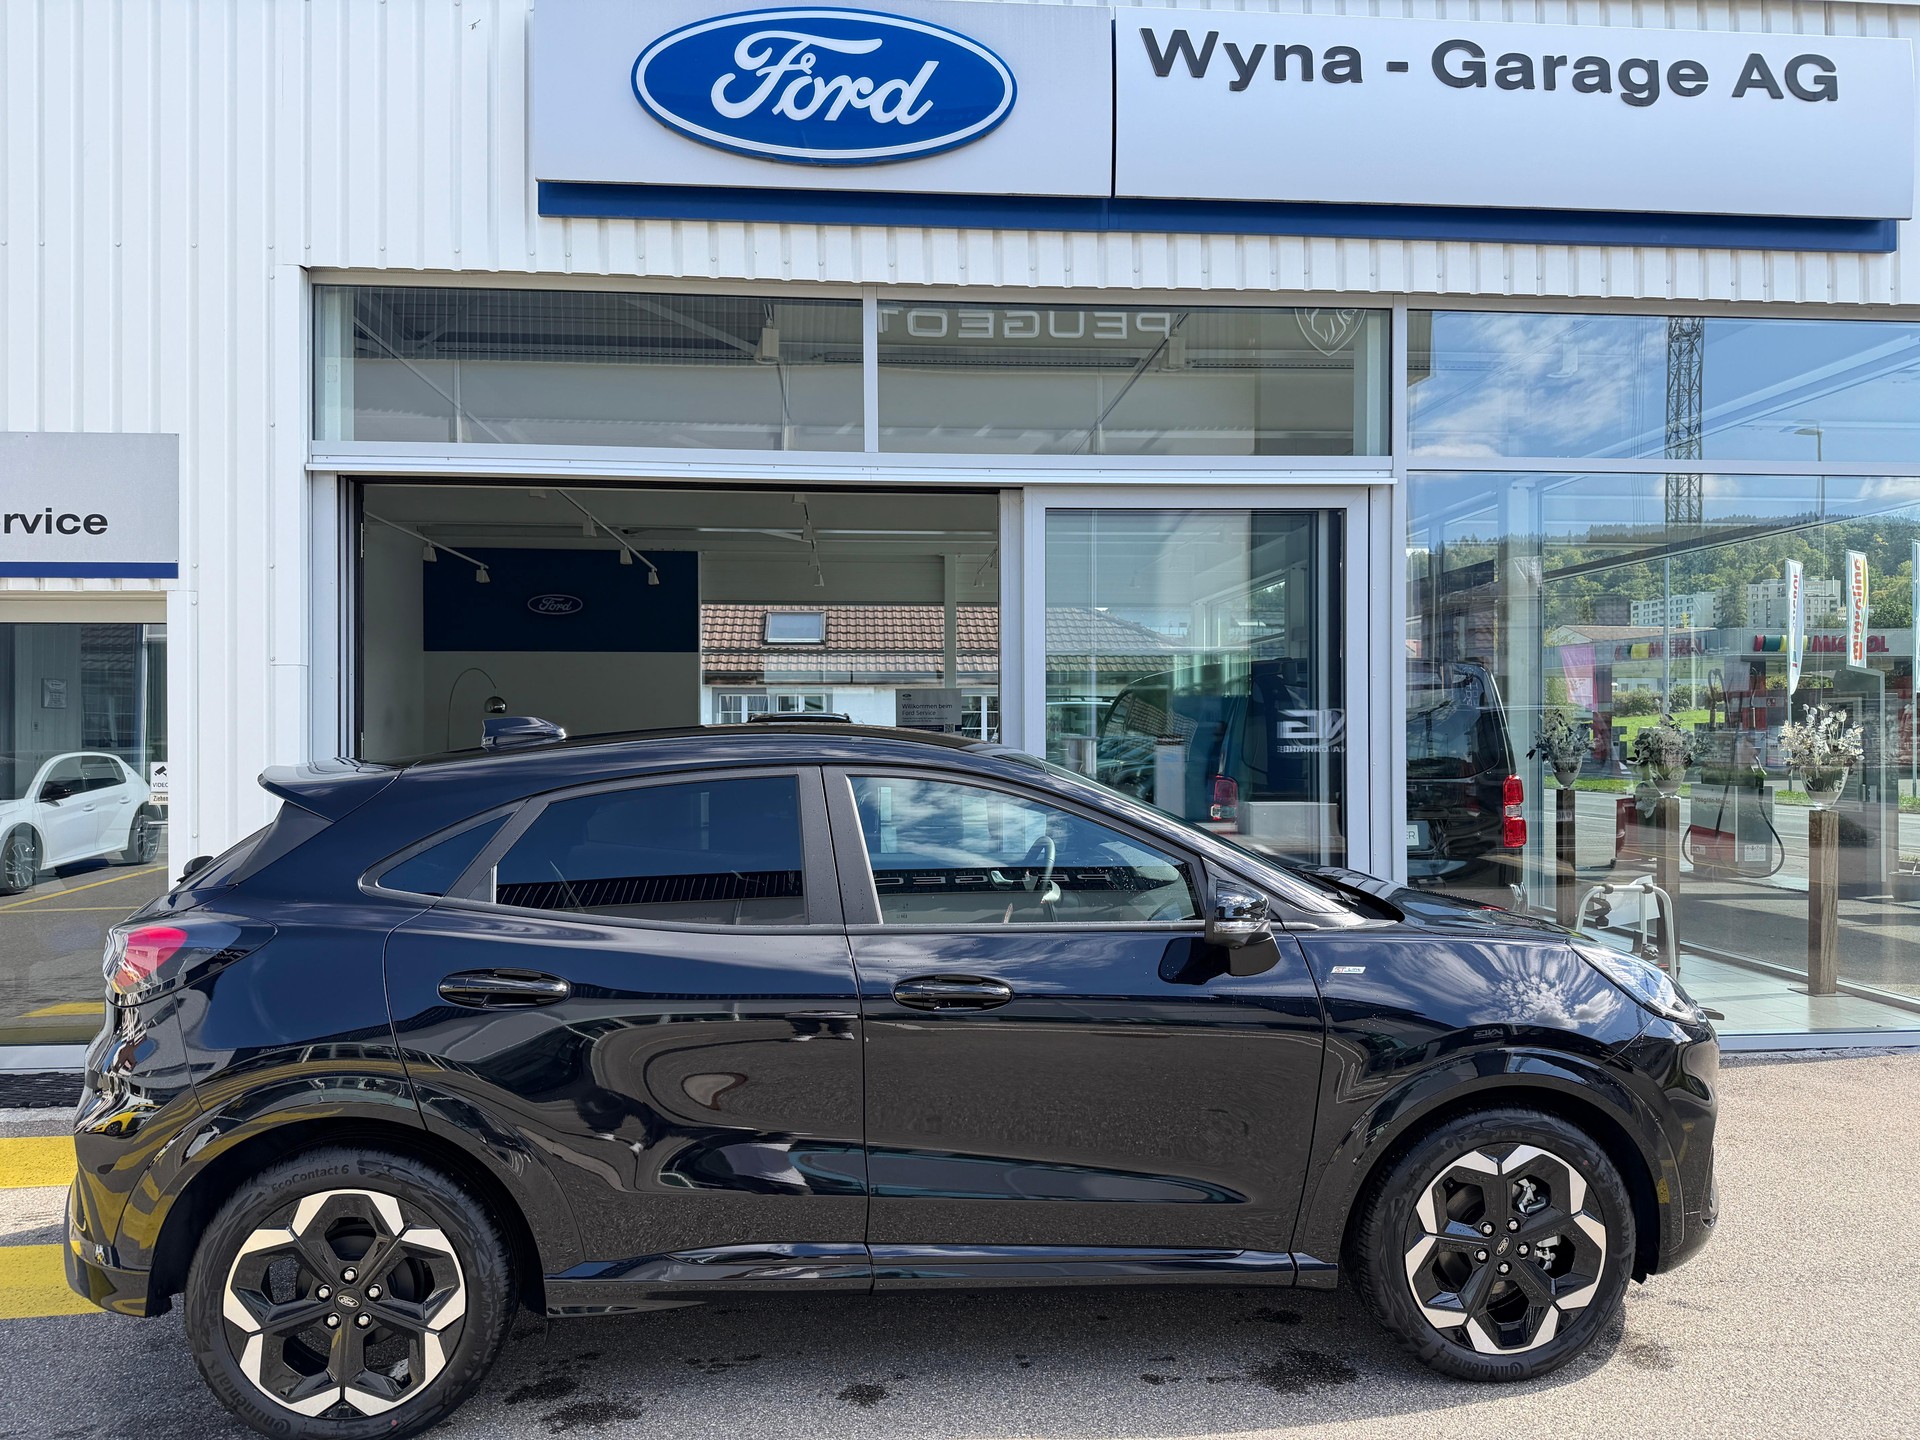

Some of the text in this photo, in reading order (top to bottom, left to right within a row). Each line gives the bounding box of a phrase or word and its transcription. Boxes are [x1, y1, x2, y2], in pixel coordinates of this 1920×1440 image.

[710, 30, 940, 126] Ford
[1139, 27, 1363, 92] Wyna
[1431, 39, 1709, 107] Garage
[1731, 53, 1839, 102] AG
[539, 597, 573, 611] Ford
[1811, 635, 1889, 653] MIGOL
[271, 1164, 350, 1193] EcoContact 6
